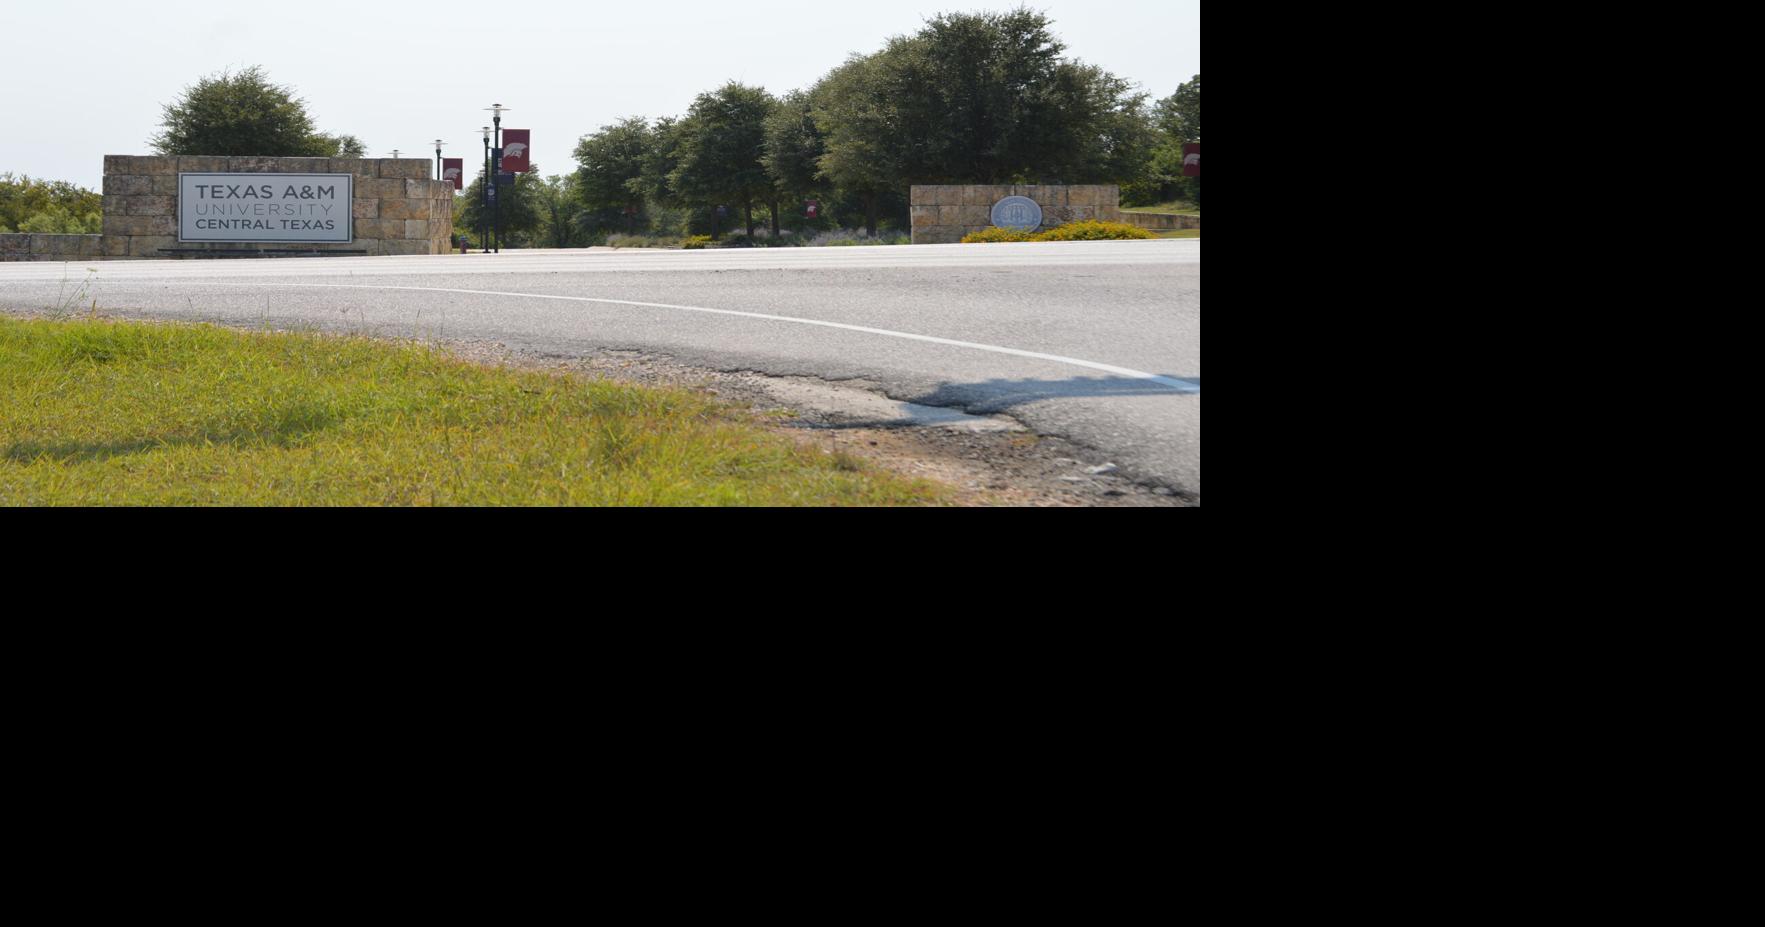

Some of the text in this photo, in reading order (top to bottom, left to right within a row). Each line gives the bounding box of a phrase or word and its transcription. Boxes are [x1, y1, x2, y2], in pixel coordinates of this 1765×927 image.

[195, 184, 335, 200] TEXAS A&M
[195, 203, 334, 216] UNIVERSITY
[195, 219, 335, 230] CENTRAL TEXAS
